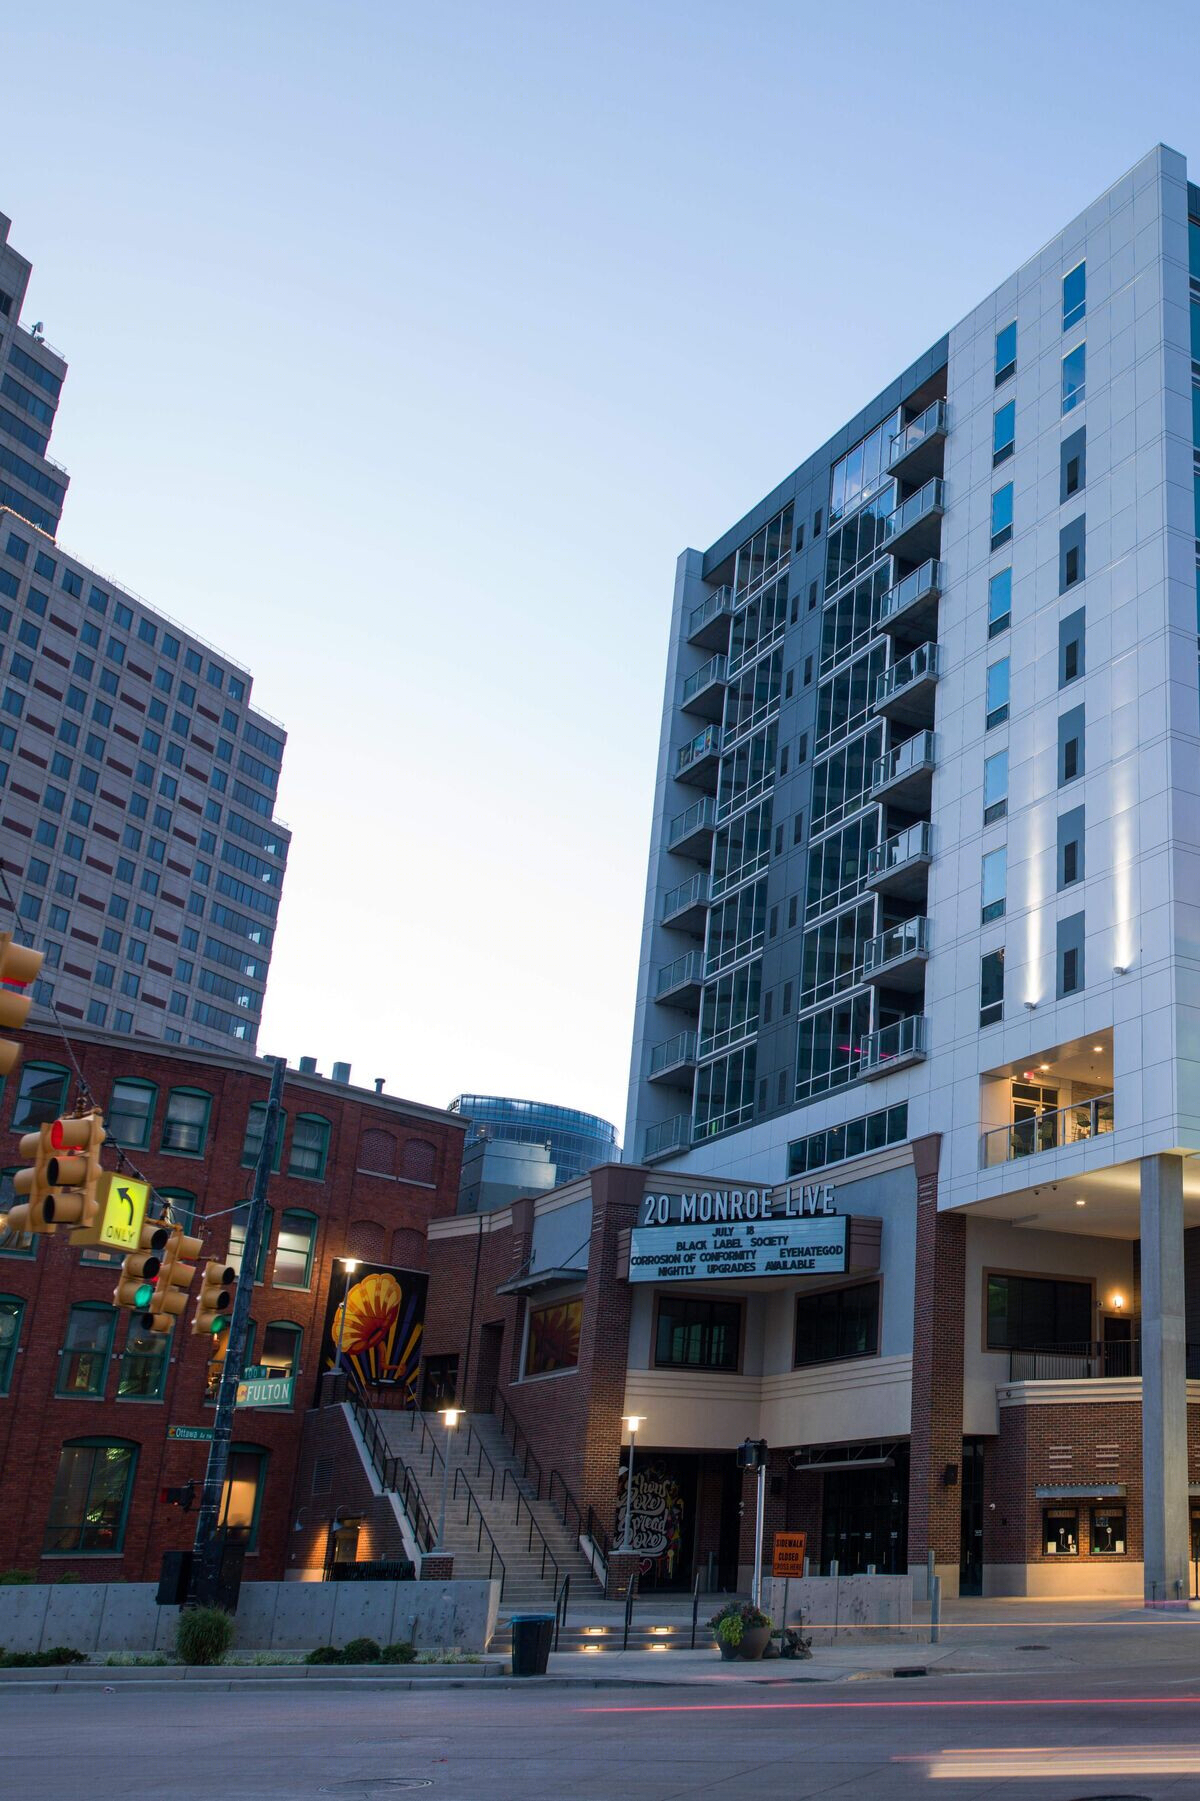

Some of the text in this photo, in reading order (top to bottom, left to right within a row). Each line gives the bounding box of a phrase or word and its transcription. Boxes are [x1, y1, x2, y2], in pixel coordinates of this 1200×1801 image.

[644, 1184, 835, 1224] 20 MONROE LIVE
[106, 1226, 136, 1243] ONLY
[712, 1225, 755, 1237] JULY 18
[676, 1235, 789, 1251] BLACK LABEL SOCIETY
[631, 1245, 843, 1266] CORROSION OF CONFORMITY EYEHATEGOD
[658, 1259, 816, 1277] NIGHTLY UPGRADES AVAILABLE
[246, 1383, 290, 1401] FULTON
[176, 1427, 198, 1439] Ottawa
[776, 1539, 804, 1548] SIDEWALK
[778, 1552, 799, 1561] CLOSED
